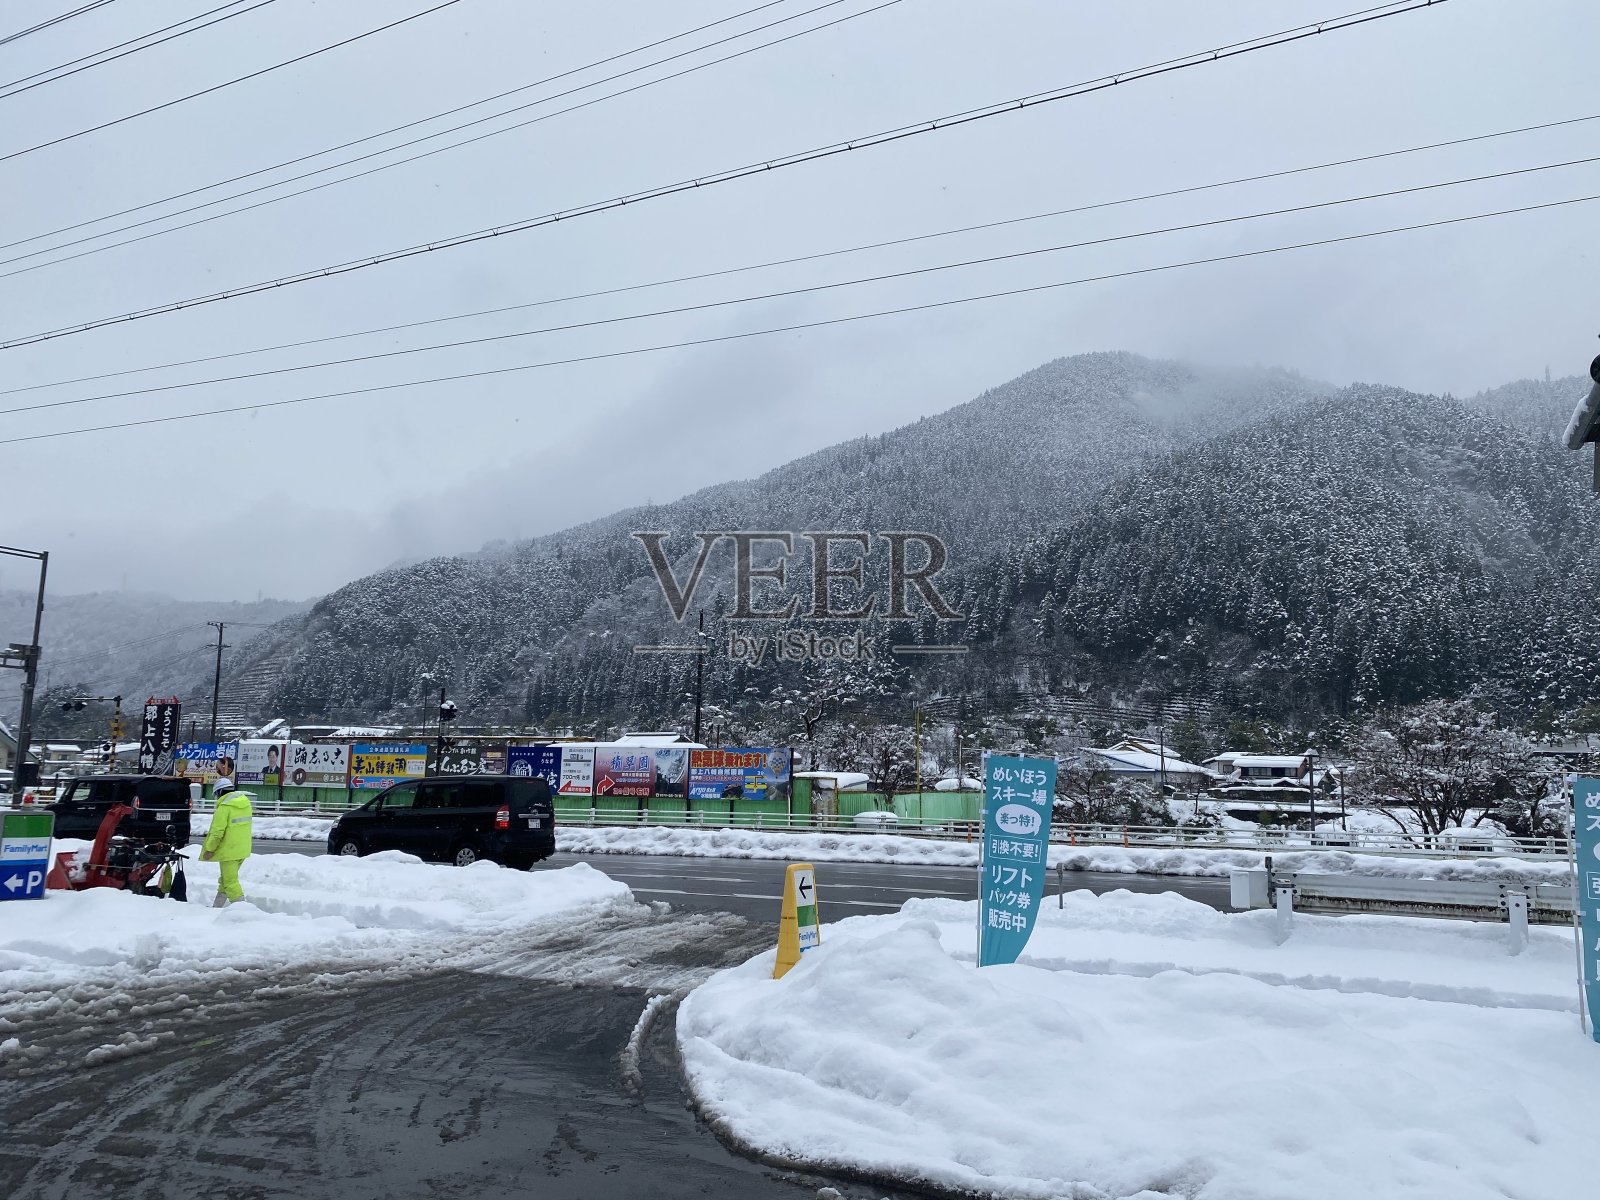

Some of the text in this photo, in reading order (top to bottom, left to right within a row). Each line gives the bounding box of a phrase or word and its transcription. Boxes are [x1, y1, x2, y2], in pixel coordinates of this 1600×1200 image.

[161, 706, 173, 748] ようこそ
[179, 744, 236, 760] サンプルの岩崎
[992, 767, 1047, 785] めいほう
[992, 786, 1047, 806] スキー場
[4, 845, 48, 854] FamilyMart
[992, 839, 1039, 858] 引換不要!
[26, 870, 43, 894] P
[992, 865, 1033, 888] リフト
[989, 888, 1031, 909] パック券
[988, 908, 1027, 933] 販売中
